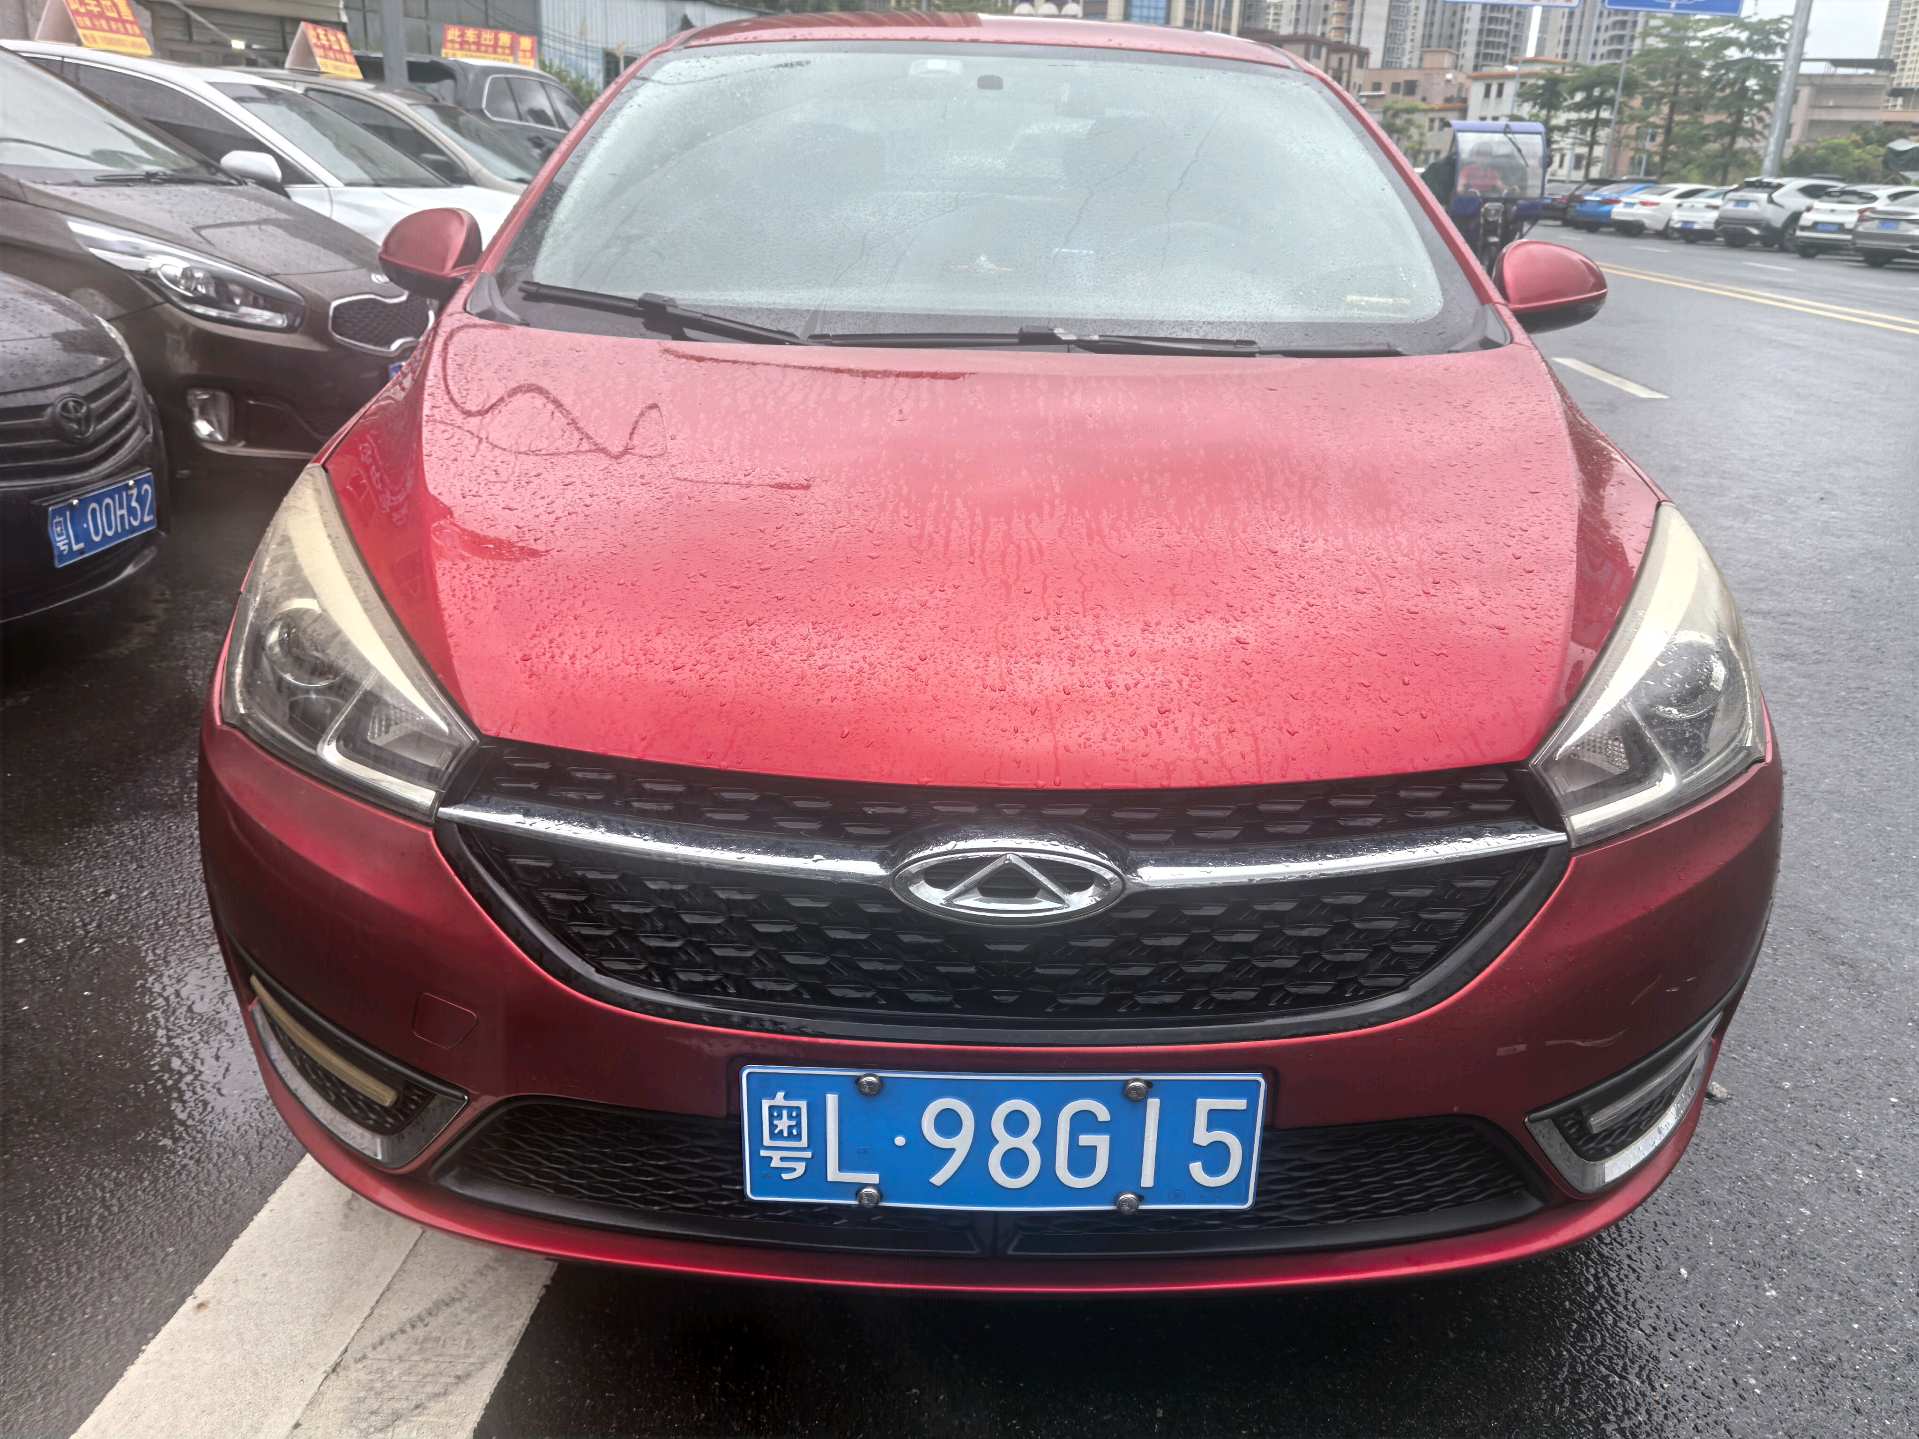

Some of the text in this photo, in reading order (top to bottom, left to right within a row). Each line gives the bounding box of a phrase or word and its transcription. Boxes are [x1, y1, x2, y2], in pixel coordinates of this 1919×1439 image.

[447, 27, 512, 47] 此车出售
[760, 1091, 1248, 1189] 粤L·98G15
